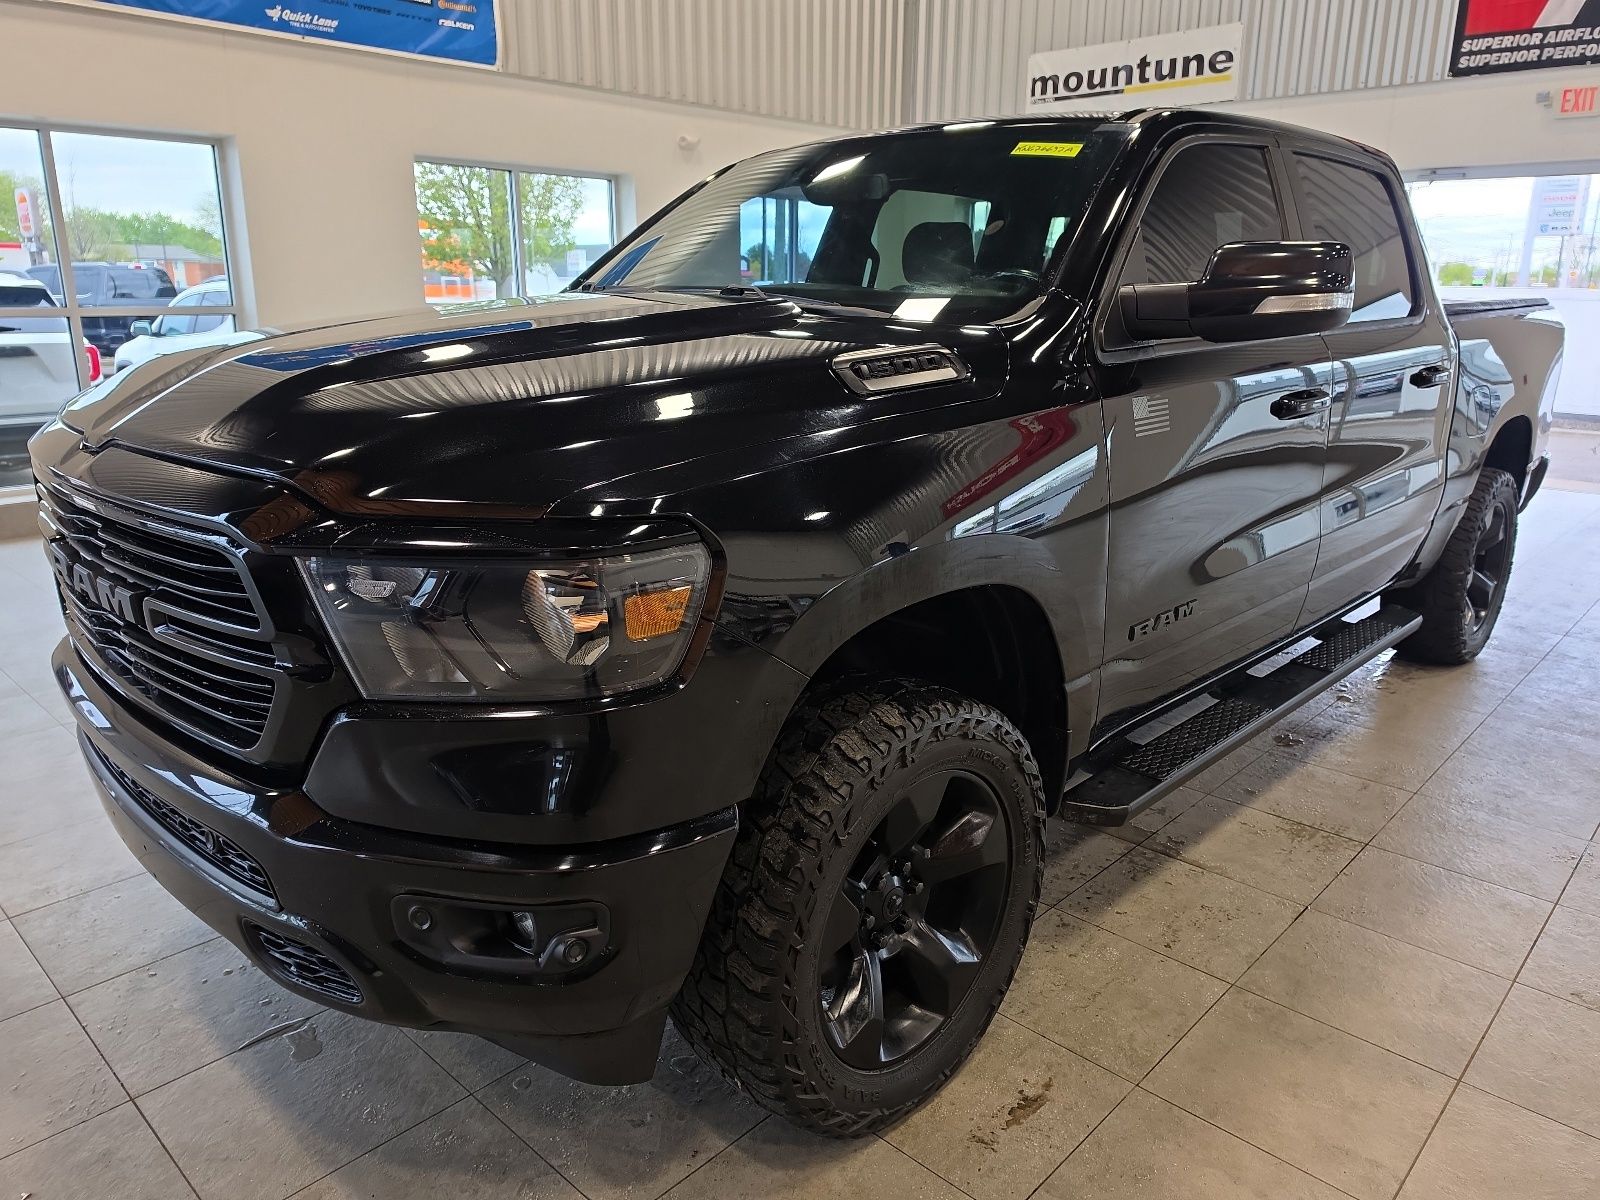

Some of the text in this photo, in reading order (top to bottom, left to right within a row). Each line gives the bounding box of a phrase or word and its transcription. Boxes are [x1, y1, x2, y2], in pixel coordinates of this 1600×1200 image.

[282, 8, 339, 28] Quick Lane
[1458, 43, 1600, 68] SUPERIOR PERFO
[1461, 33, 1543, 52] SUPERIOR
[1031, 50, 1234, 97] mountune
[1560, 87, 1598, 113] EXIT
[50, 542, 136, 623] RAM
[1128, 598, 1198, 642] RAM
